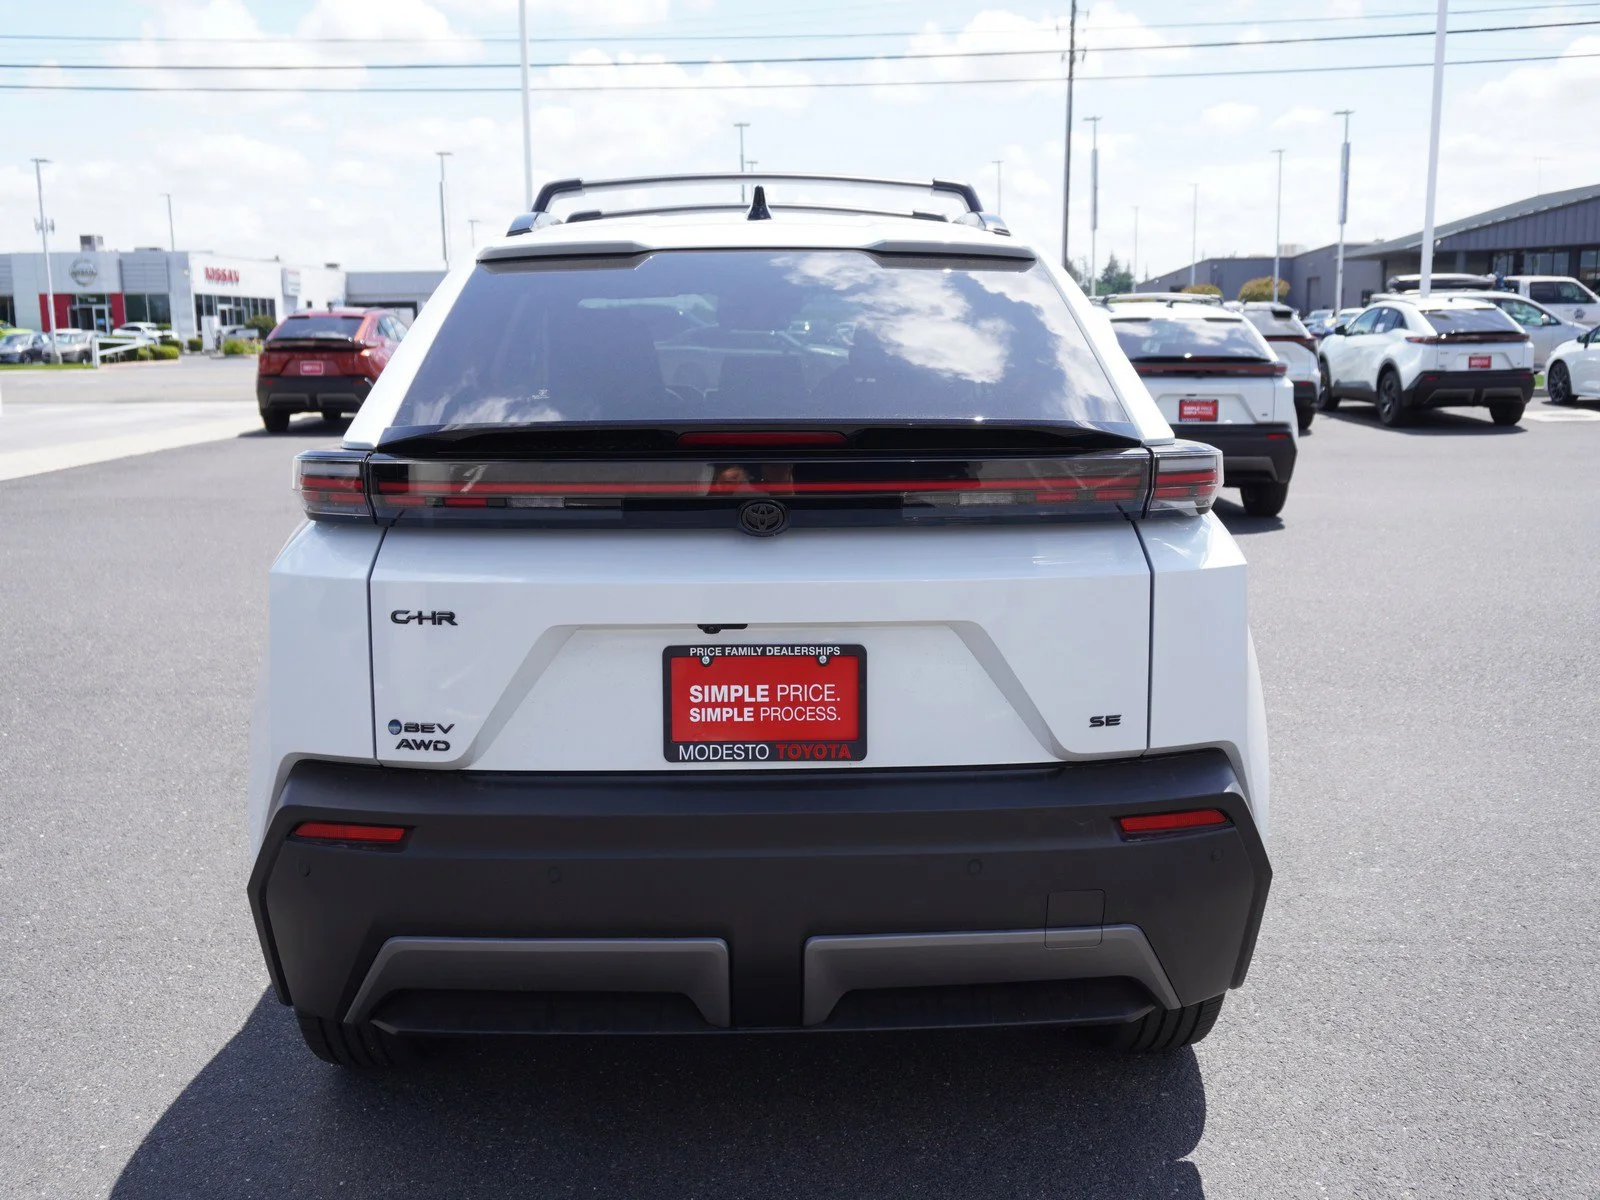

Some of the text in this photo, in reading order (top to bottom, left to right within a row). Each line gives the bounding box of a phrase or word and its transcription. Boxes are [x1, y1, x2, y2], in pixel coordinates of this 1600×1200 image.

[205, 267, 240, 283] NISSAN
[390, 609, 458, 626] C-HR
[689, 646, 841, 657] PRICE FAMILY DEALERSHIPS
[689, 683, 841, 703] SIMPLE PRICE.
[689, 706, 841, 722] SIMPLE PROCESS.
[1089, 714, 1122, 728] SE
[403, 722, 456, 734] BEV
[395, 738, 451, 752] AWD
[679, 743, 852, 761] MODESTO TOYOTA
